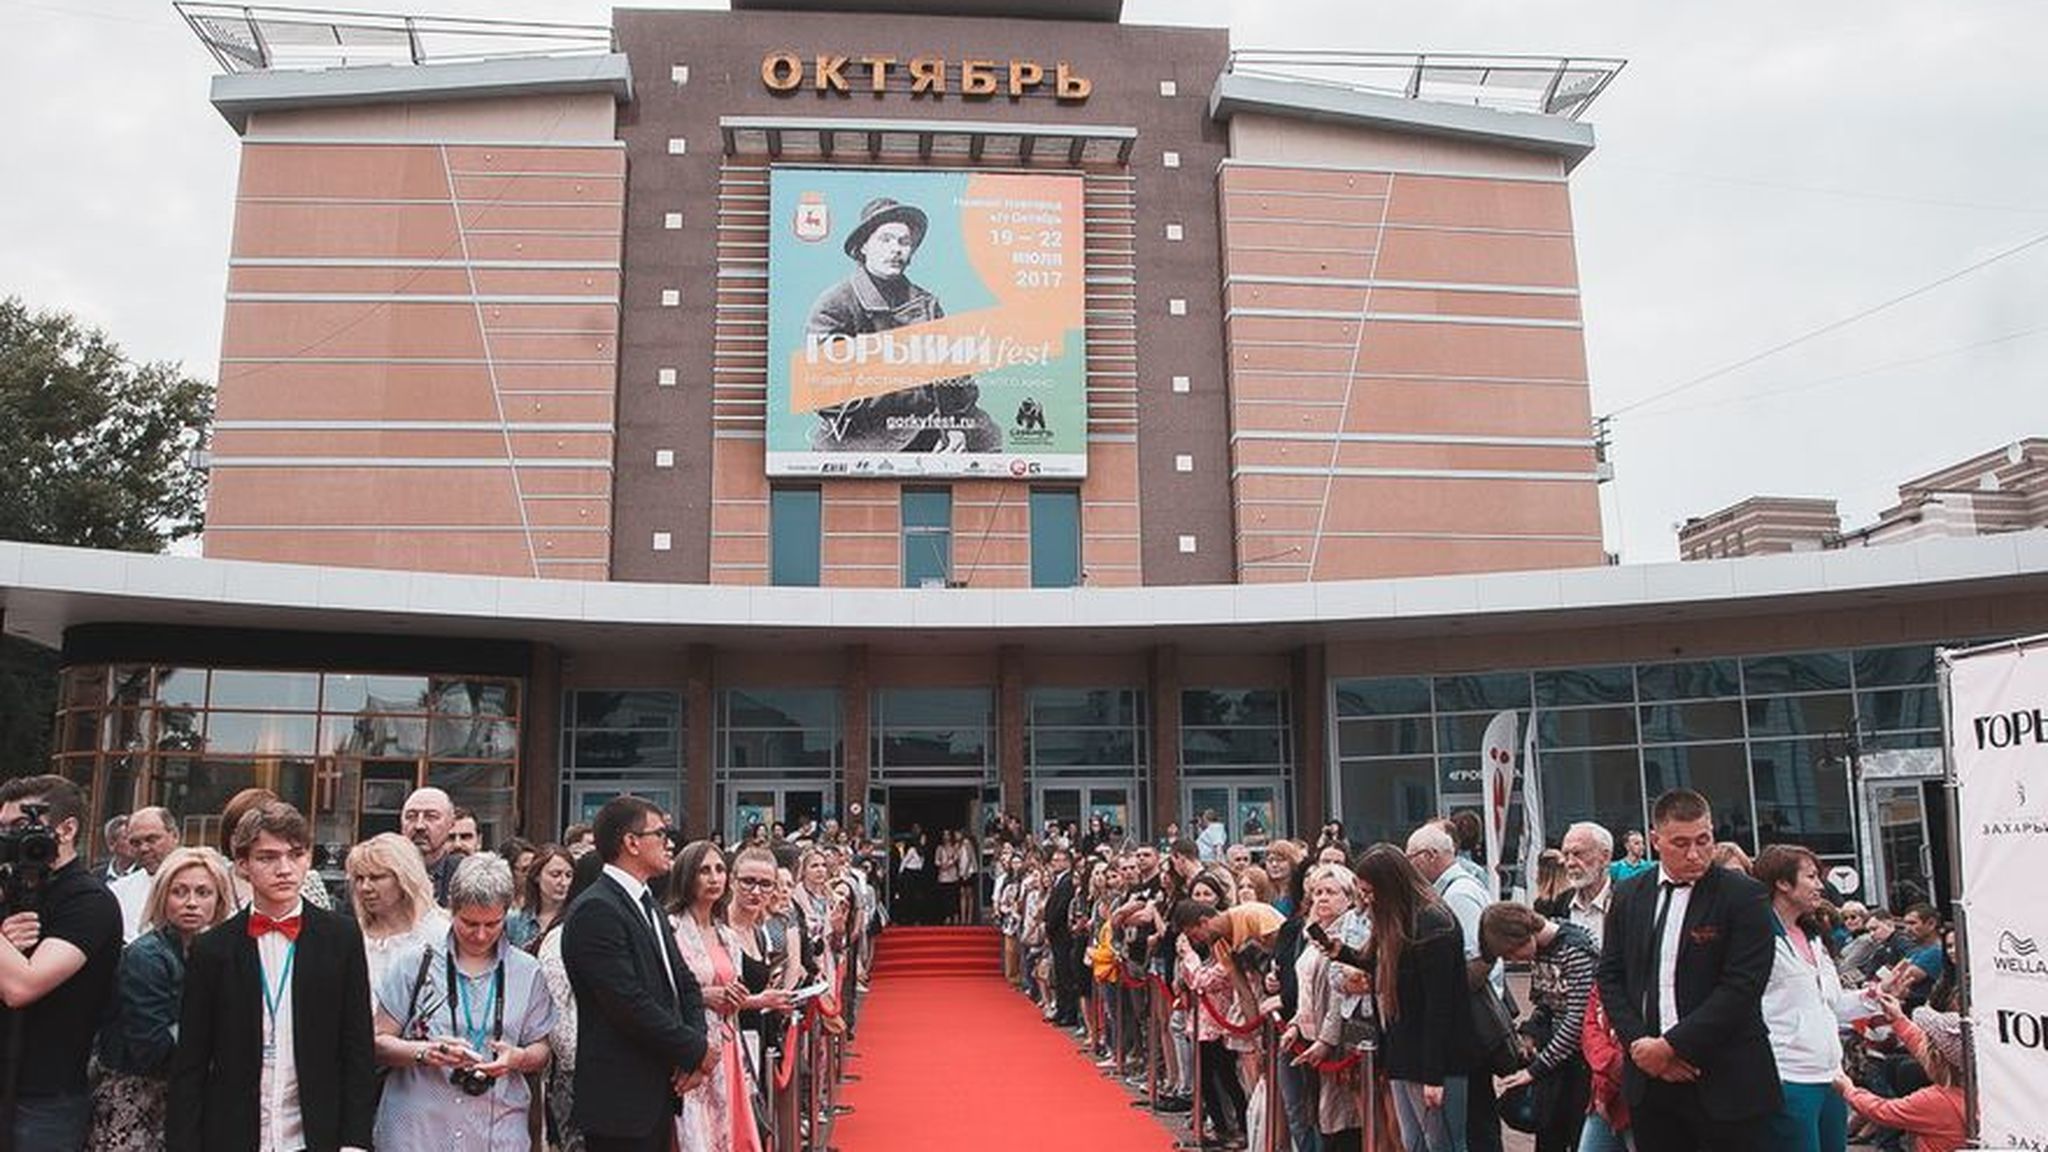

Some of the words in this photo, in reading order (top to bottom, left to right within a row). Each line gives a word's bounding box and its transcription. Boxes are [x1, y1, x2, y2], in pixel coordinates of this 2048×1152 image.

[760, 48, 1093, 100] ОКТЯБРЬ
[989, 229, 1013, 246] 19
[1040, 230, 1062, 248] 22
[1016, 270, 1062, 289] 2017
[885, 413, 976, 431] gorkyfest.ru
